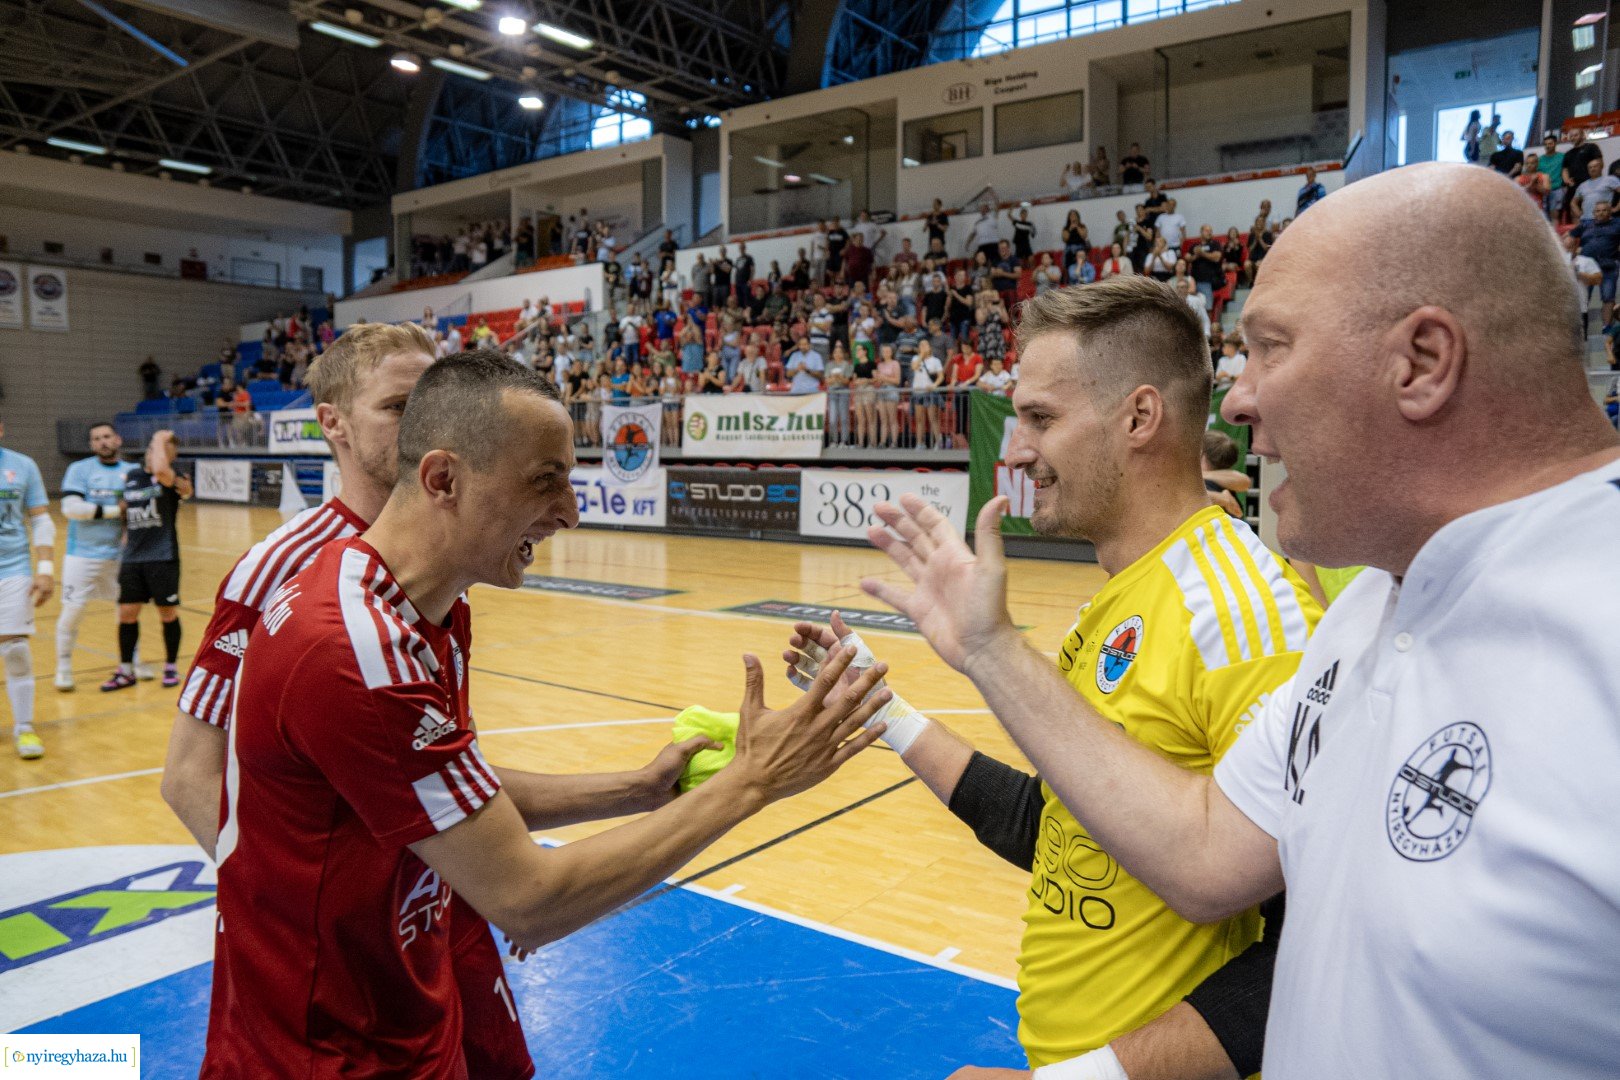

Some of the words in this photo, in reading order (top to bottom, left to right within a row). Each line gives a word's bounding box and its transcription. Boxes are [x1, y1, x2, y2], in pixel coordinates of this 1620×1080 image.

[716, 411, 824, 432] mlsz.hu
[921, 484, 940, 496] the
[632, 499, 656, 515] KFT
[412, 719, 458, 751] adidas
[1429, 727, 1487, 776] FUTSAL
[1391, 792, 1463, 856] NYÍREGYHÁZA
